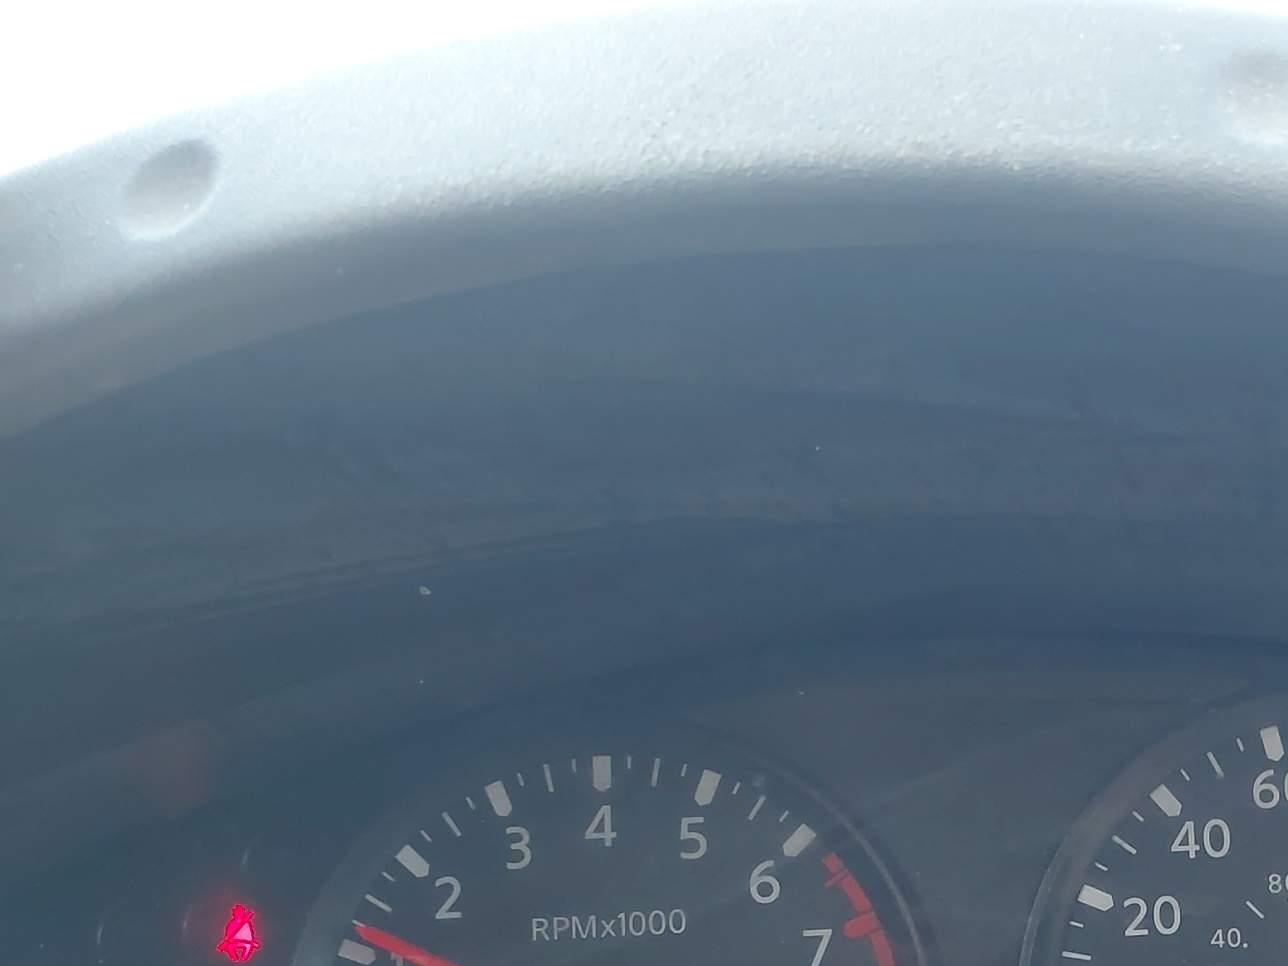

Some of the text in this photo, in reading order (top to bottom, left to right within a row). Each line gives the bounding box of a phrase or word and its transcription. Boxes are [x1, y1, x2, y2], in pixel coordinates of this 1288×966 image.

[584, 805, 617, 847] 4
[680, 817, 707, 859] 5
[1170, 818, 1231, 859] 40
[507, 826, 532, 869] 3
[434, 876, 463, 919] 2
[749, 860, 781, 903] 6
[531, 909, 687, 942] RPMx1000
[1123, 896, 1182, 937] 20
[1211, 927, 1242, 948] 40
